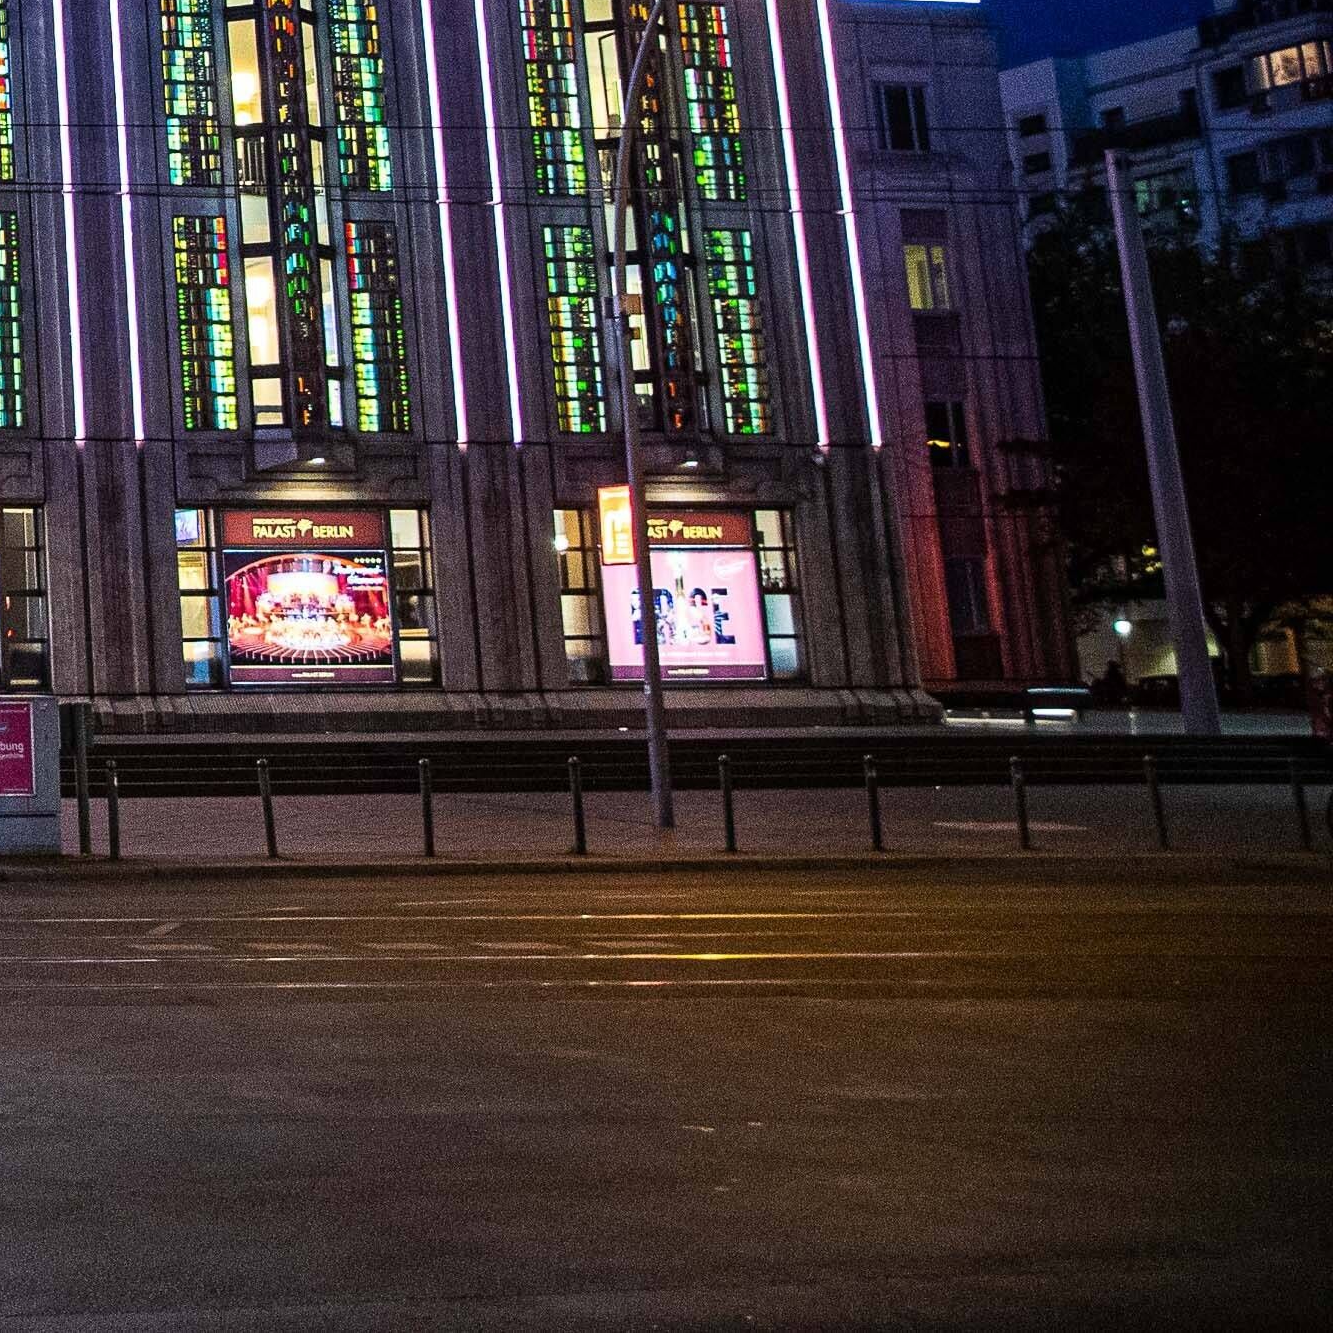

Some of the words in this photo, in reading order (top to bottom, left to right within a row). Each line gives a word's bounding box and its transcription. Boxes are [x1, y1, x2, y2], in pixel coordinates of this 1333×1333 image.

[253, 525, 296, 538] PALAST
[312, 526, 354, 538] BERLIN
[647, 526, 668, 538] AST
[683, 526, 723, 538] BERLIN
